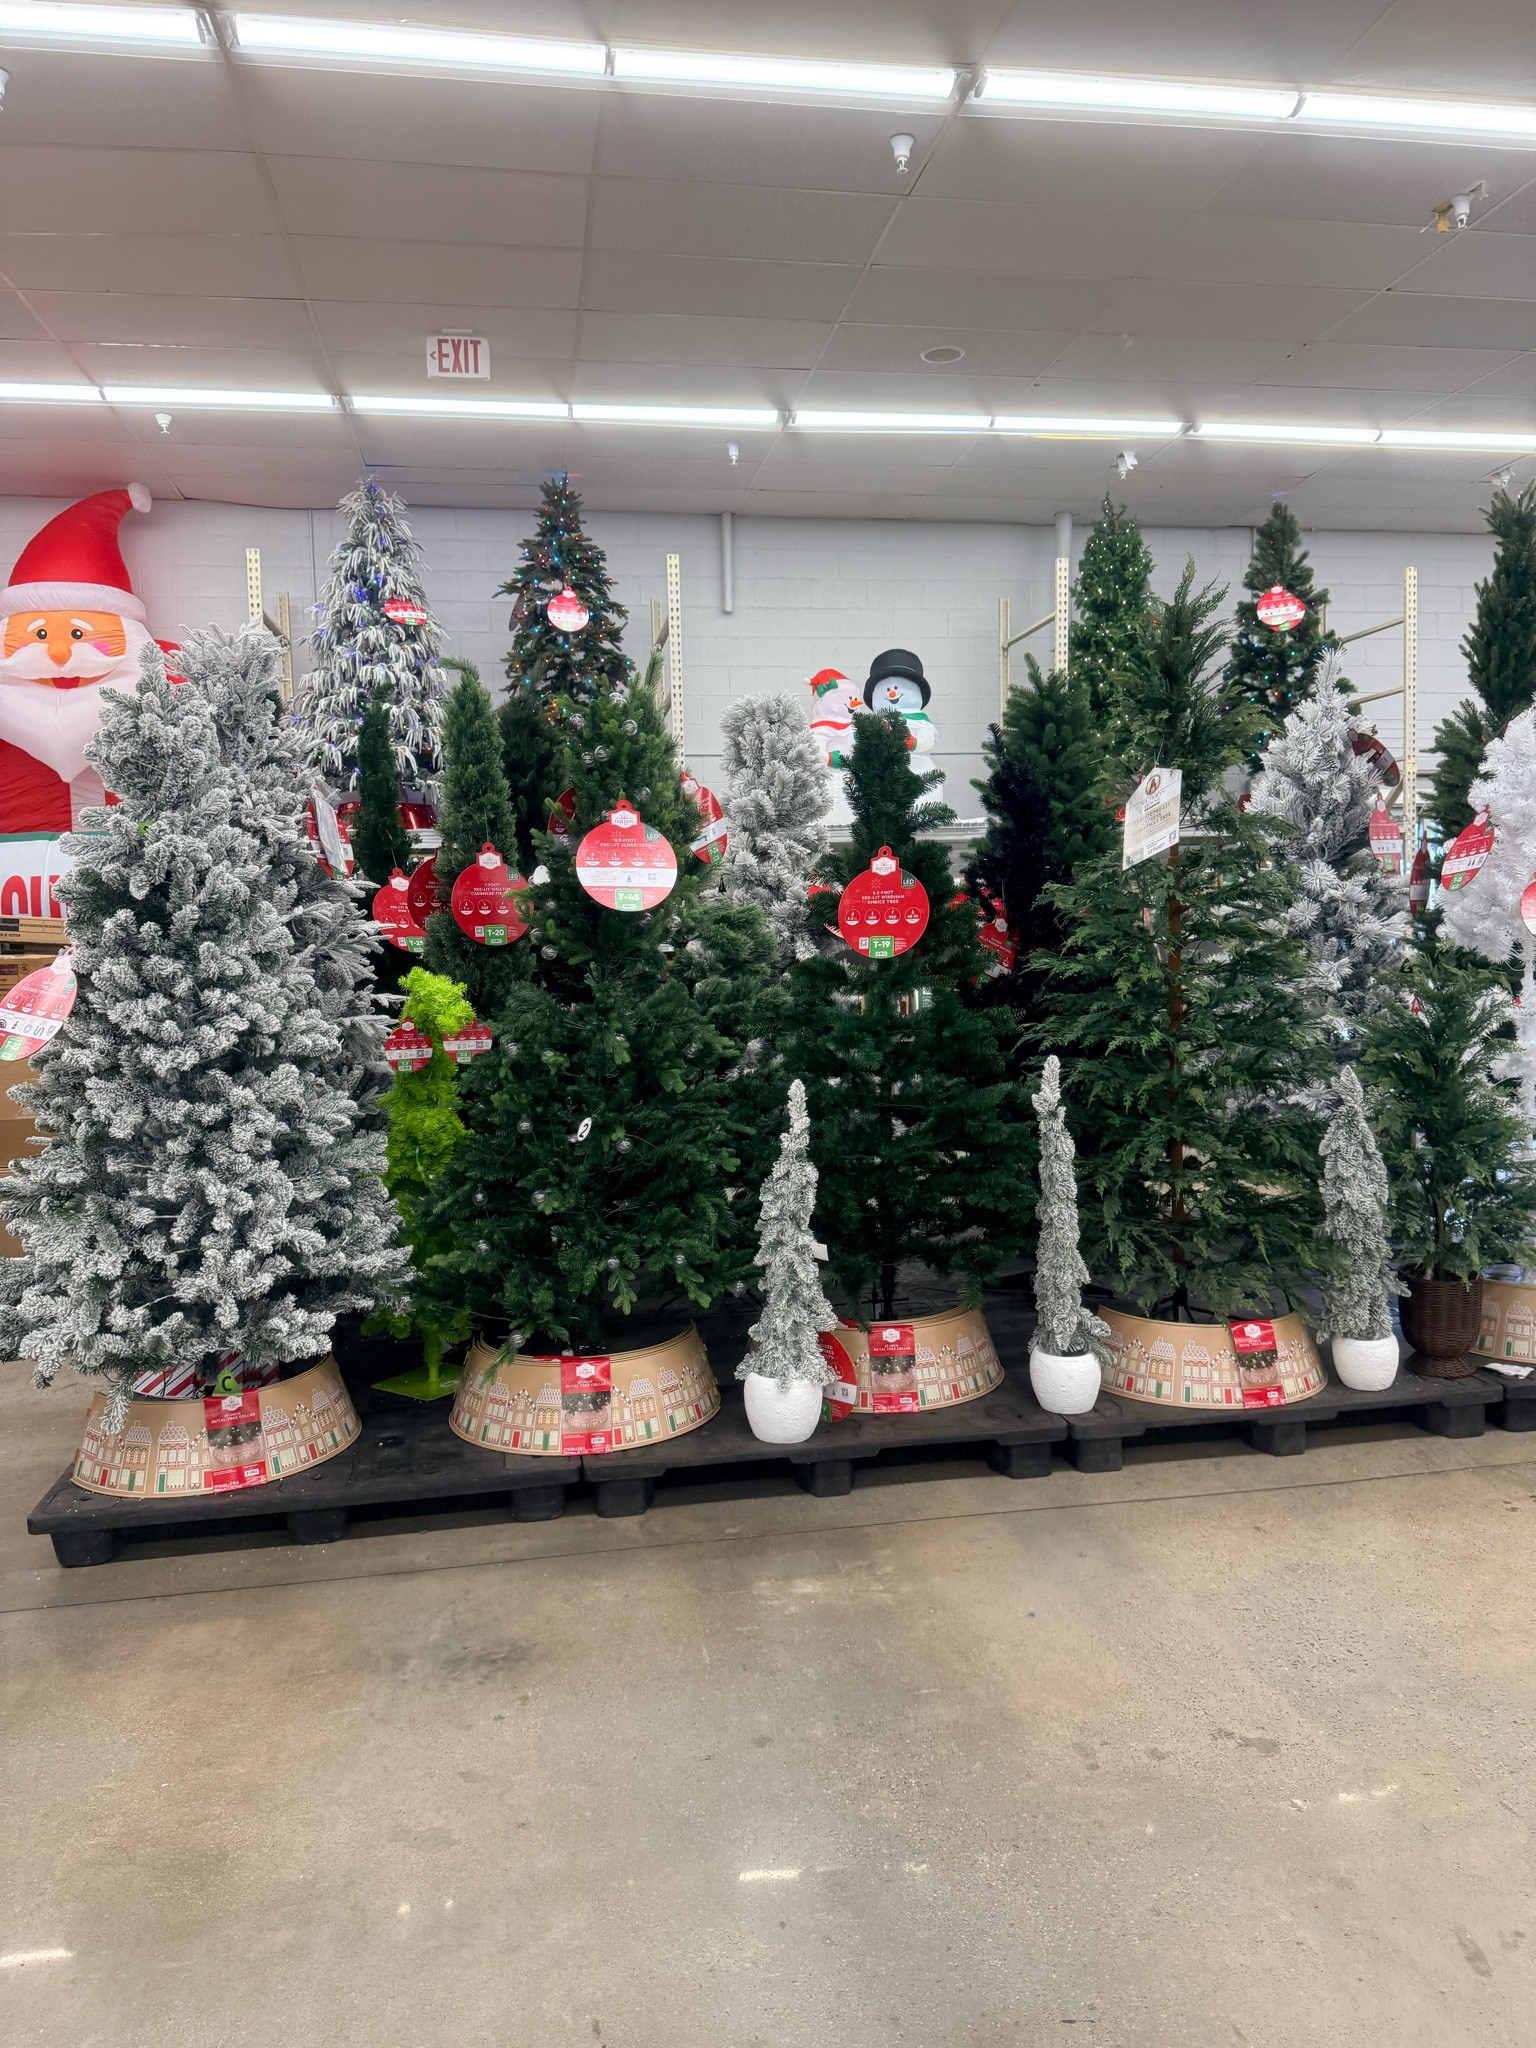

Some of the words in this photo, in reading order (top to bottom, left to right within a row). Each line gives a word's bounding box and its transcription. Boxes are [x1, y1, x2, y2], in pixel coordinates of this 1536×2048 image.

[438, 338, 481, 374] EXIT
[579, 1123, 588, 1138] 2
[222, 1376, 231, 1391] C
